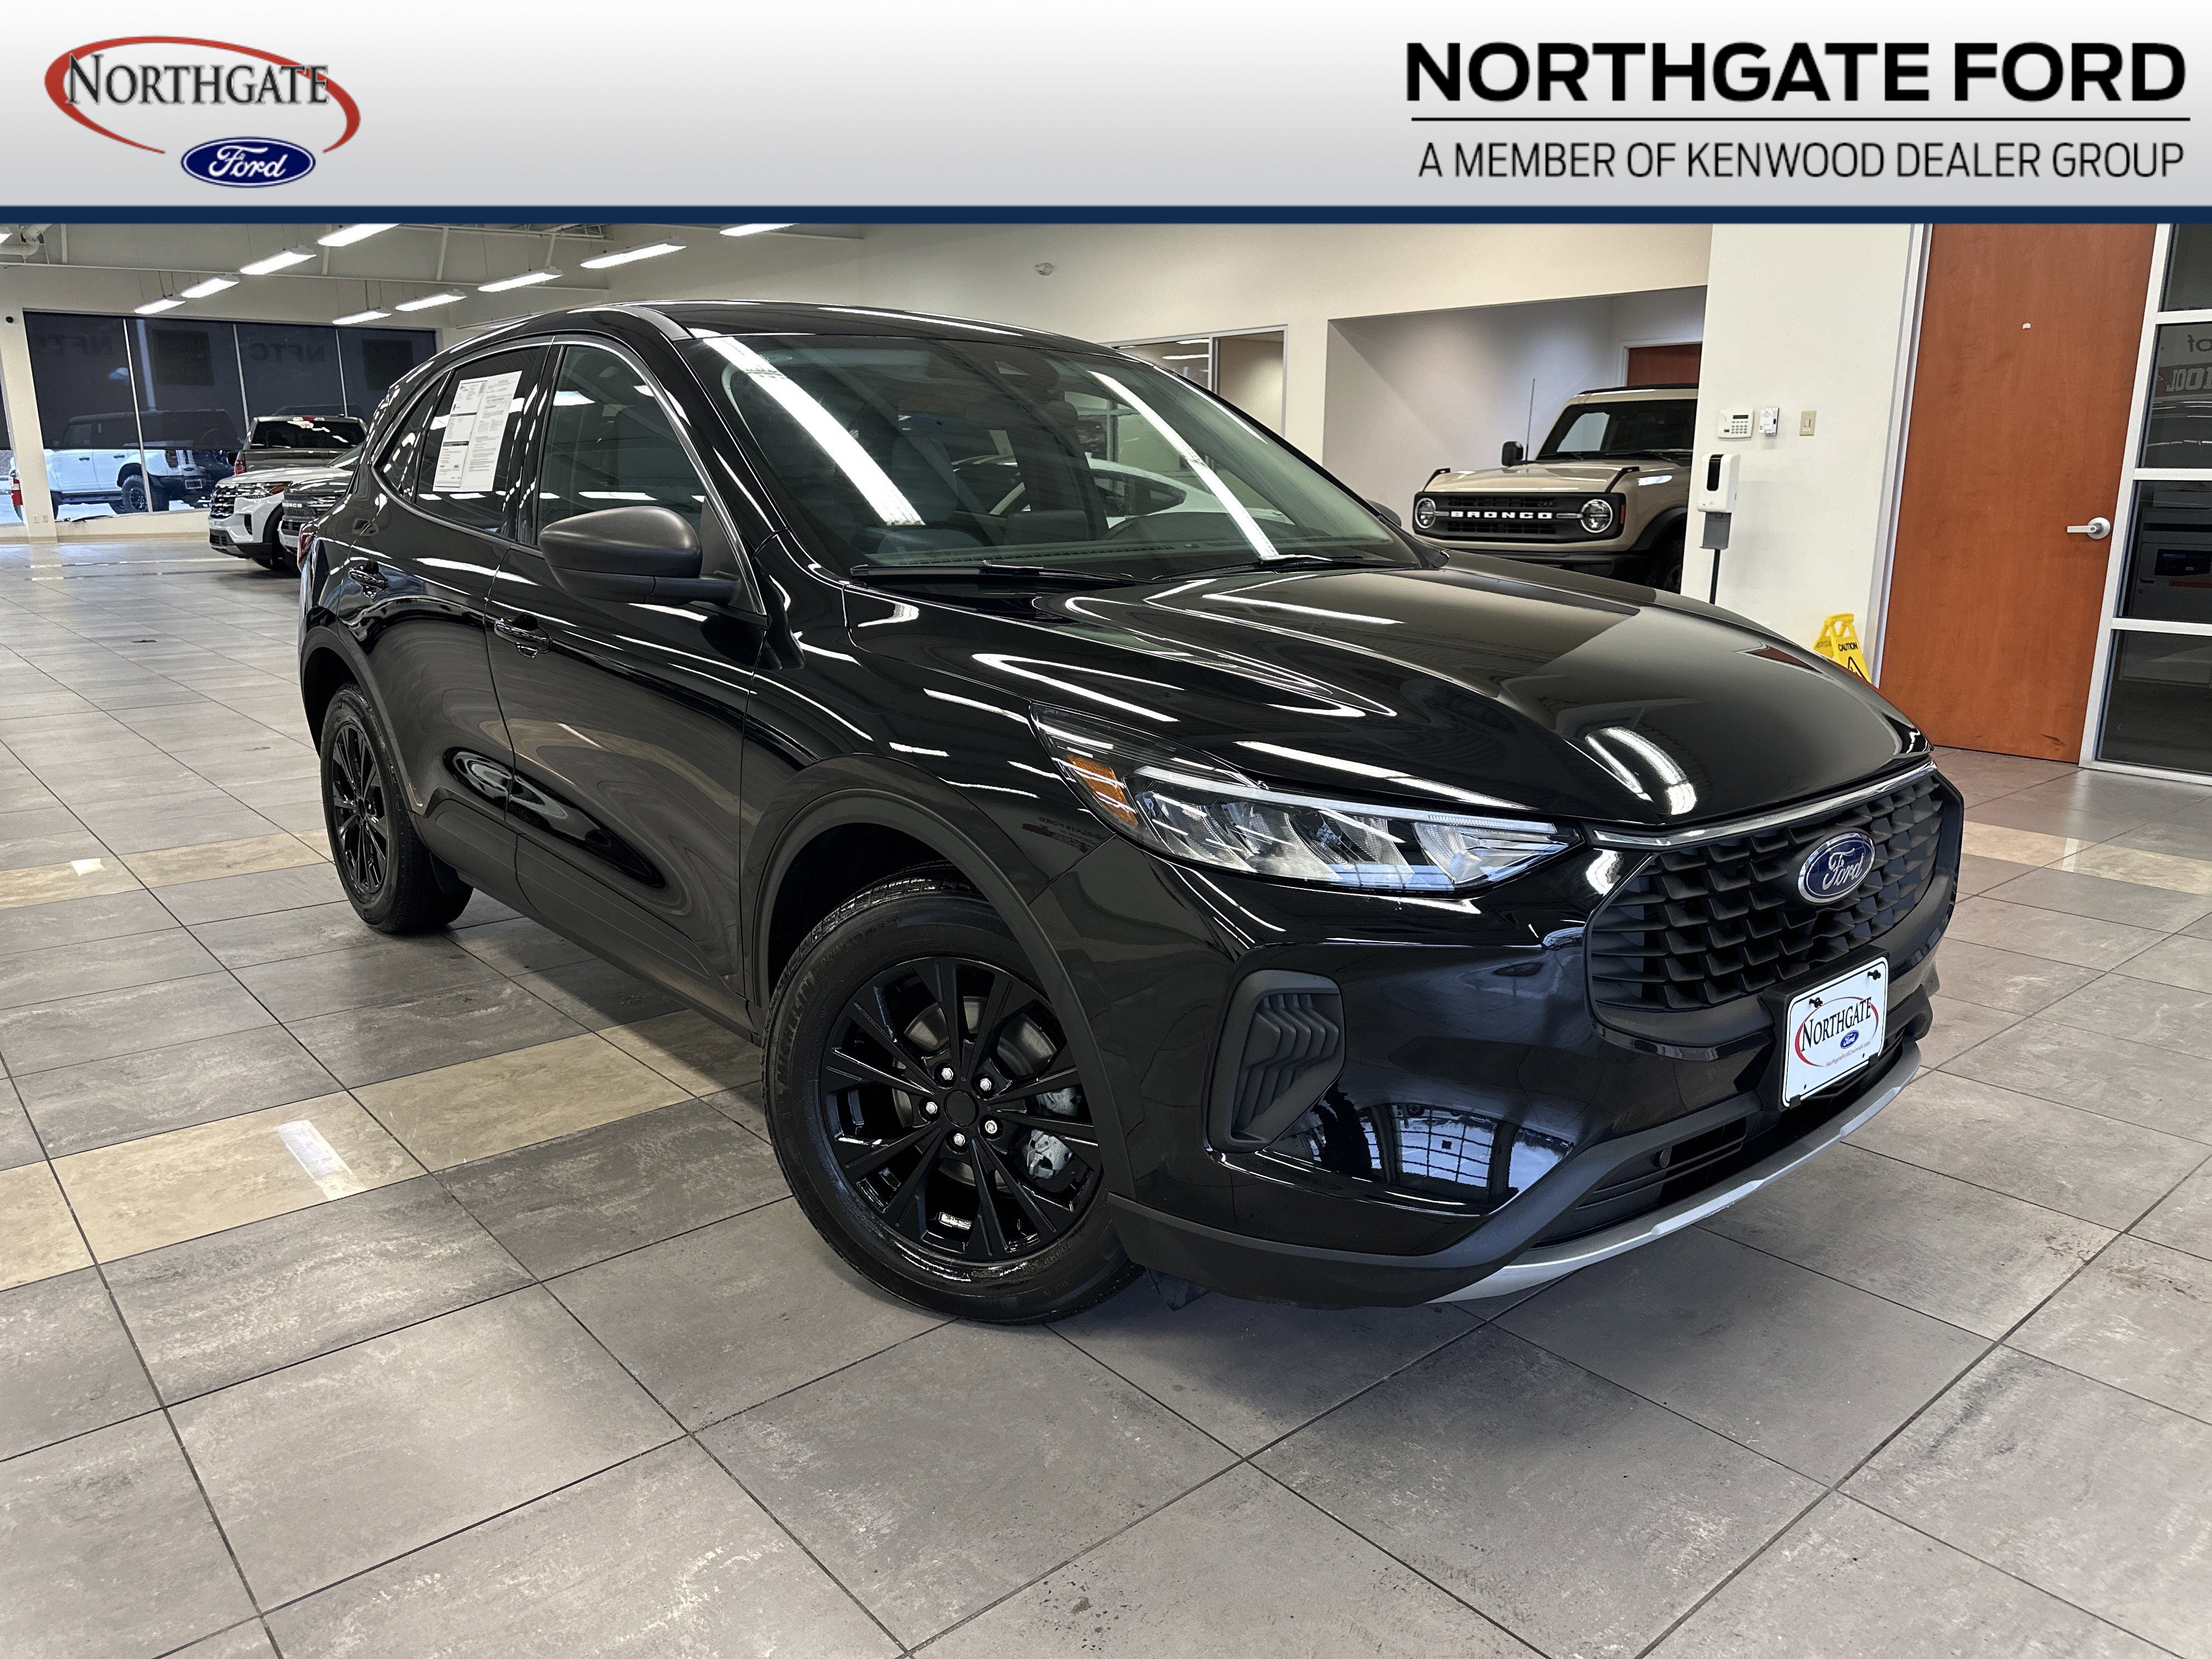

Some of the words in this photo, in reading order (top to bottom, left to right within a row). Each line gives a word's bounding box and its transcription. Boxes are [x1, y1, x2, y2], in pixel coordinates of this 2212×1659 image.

[1451, 511, 1553, 520] BRONCO
[1838, 641, 1858, 652] CAUTION
[1822, 848, 1864, 890] Ford
[1801, 996, 1872, 1052] NORTHGATE
[1843, 1032, 1856, 1046] Ford
